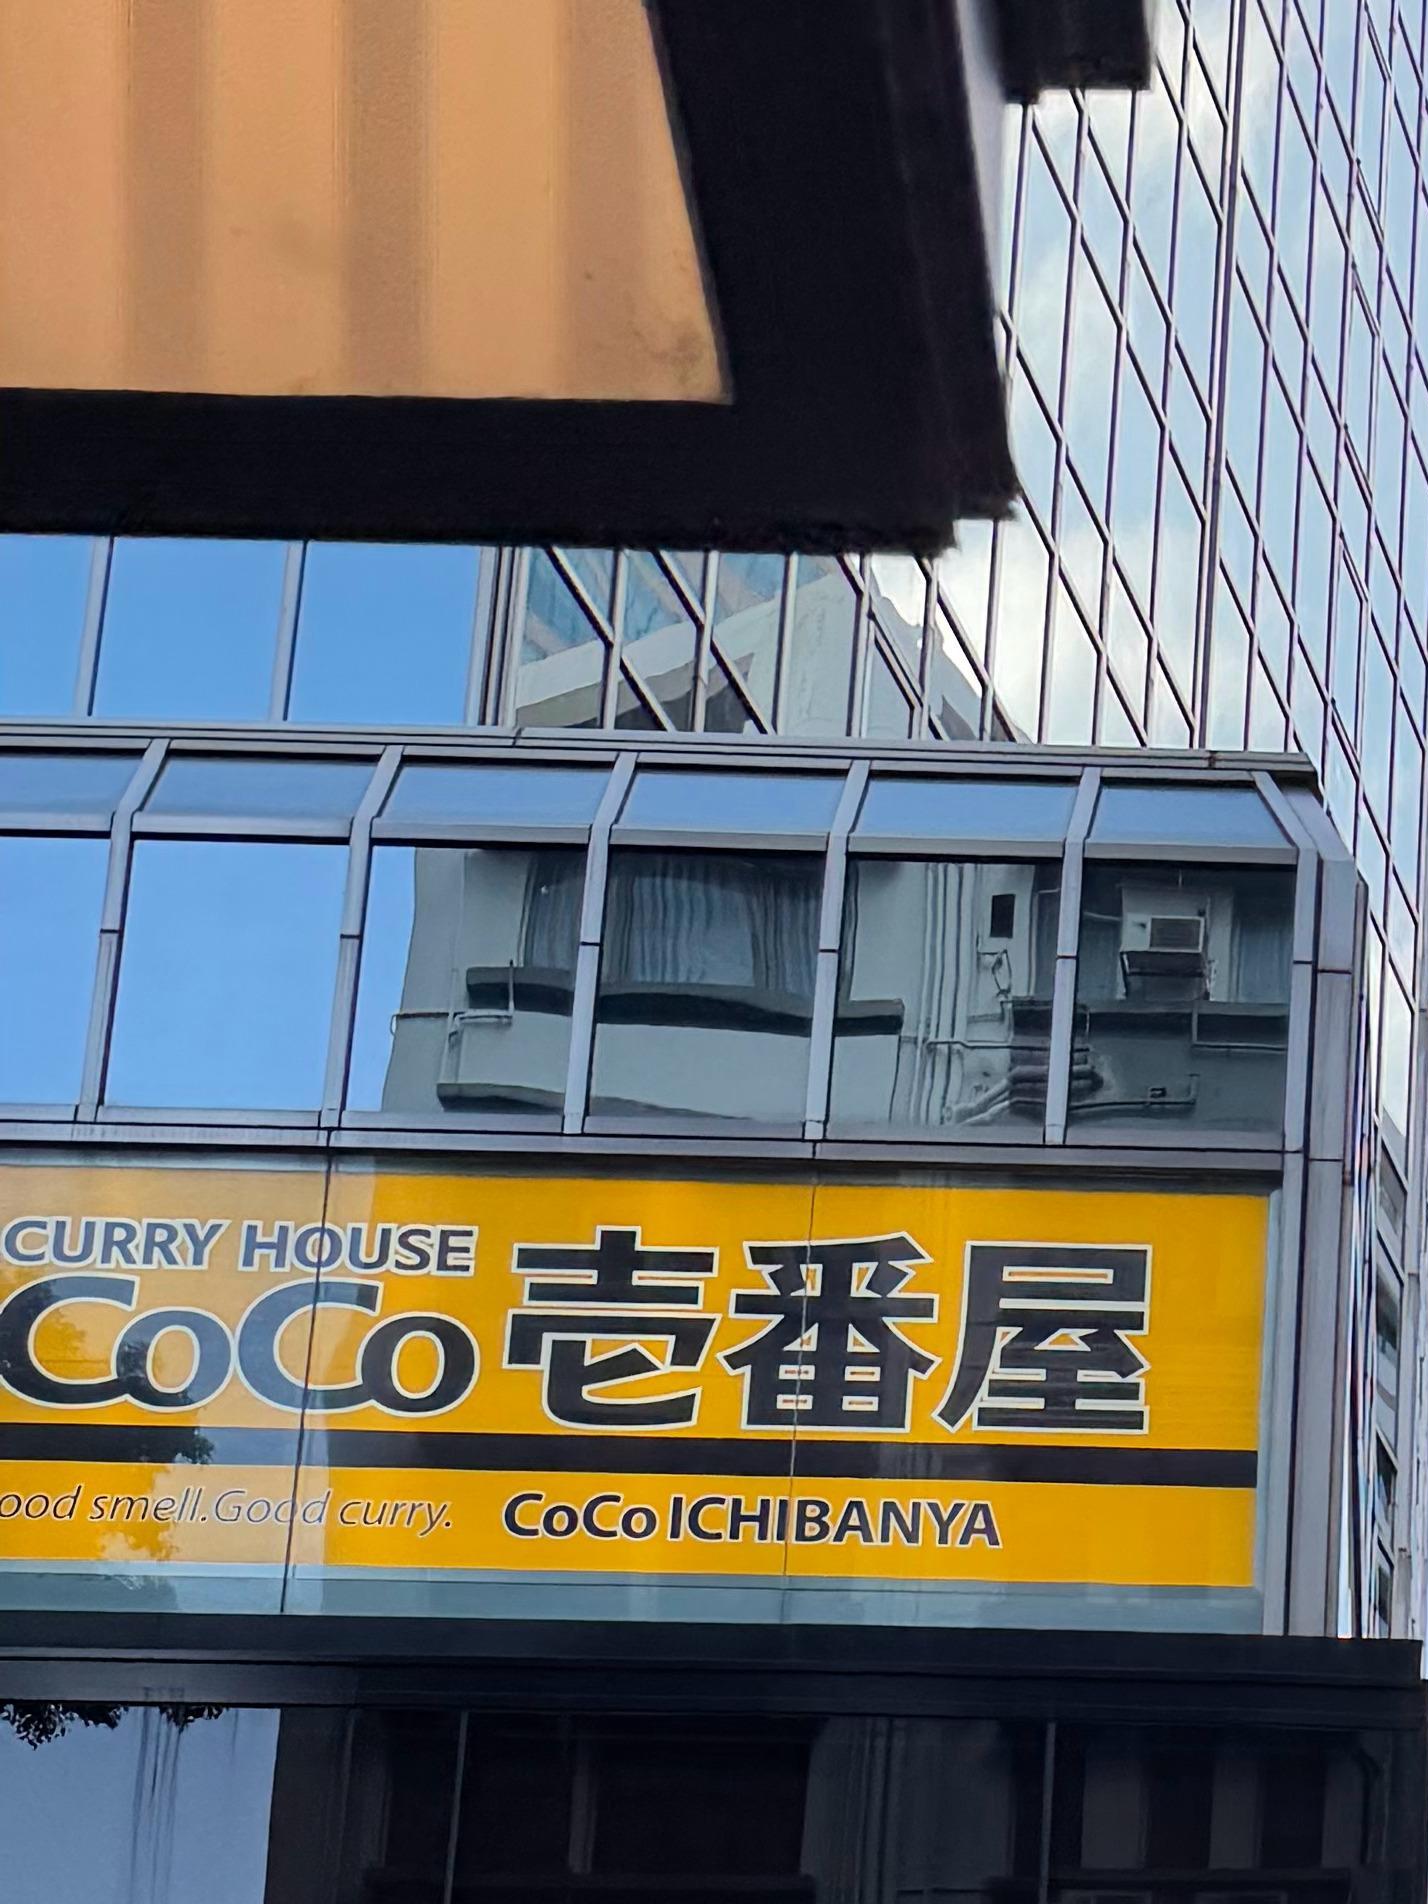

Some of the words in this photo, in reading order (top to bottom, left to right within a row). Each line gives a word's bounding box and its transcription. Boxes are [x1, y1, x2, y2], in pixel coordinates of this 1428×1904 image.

[2, 1216, 229, 1270] CURRY
[238, 1220, 479, 1275] HOUSE
[0, 1273, 480, 1416] CoCo
[502, 1225, 1152, 1434] 壱番屋
[0, 1485, 83, 1521] ood
[339, 1498, 453, 1537] curry.
[503, 1492, 659, 1541] CoCo
[667, 1494, 1003, 1548] ICHIBANYA
